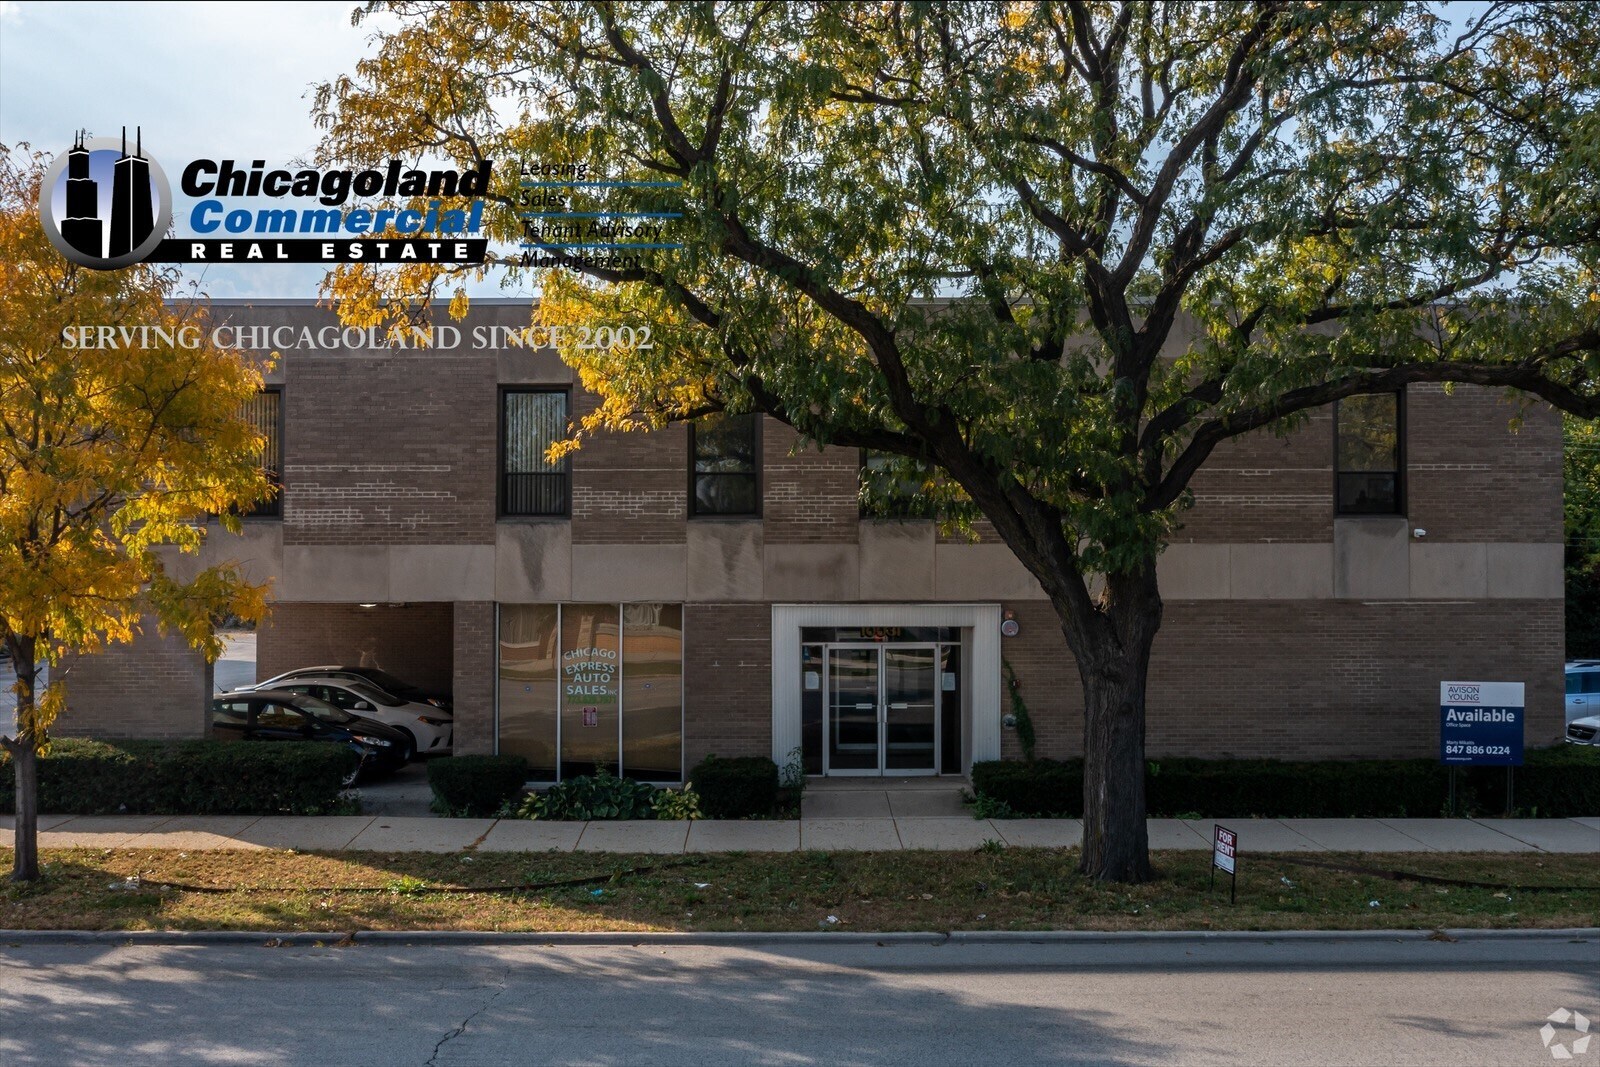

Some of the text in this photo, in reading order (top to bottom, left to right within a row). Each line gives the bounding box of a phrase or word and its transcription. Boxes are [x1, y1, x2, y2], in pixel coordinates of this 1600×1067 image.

[563, 647, 616, 661] CHICAGO
[565, 661, 615, 675] EXPRESS
[574, 673, 610, 683] AUTO
[566, 685, 607, 695] SALES
[1448, 693, 1480, 701] YOUNG
[1446, 708, 1515, 722] Available
[1446, 745, 1510, 754] 847 886 0224
[1219, 831, 1232, 845] FOR
[1217, 841, 1234, 856] RENT
